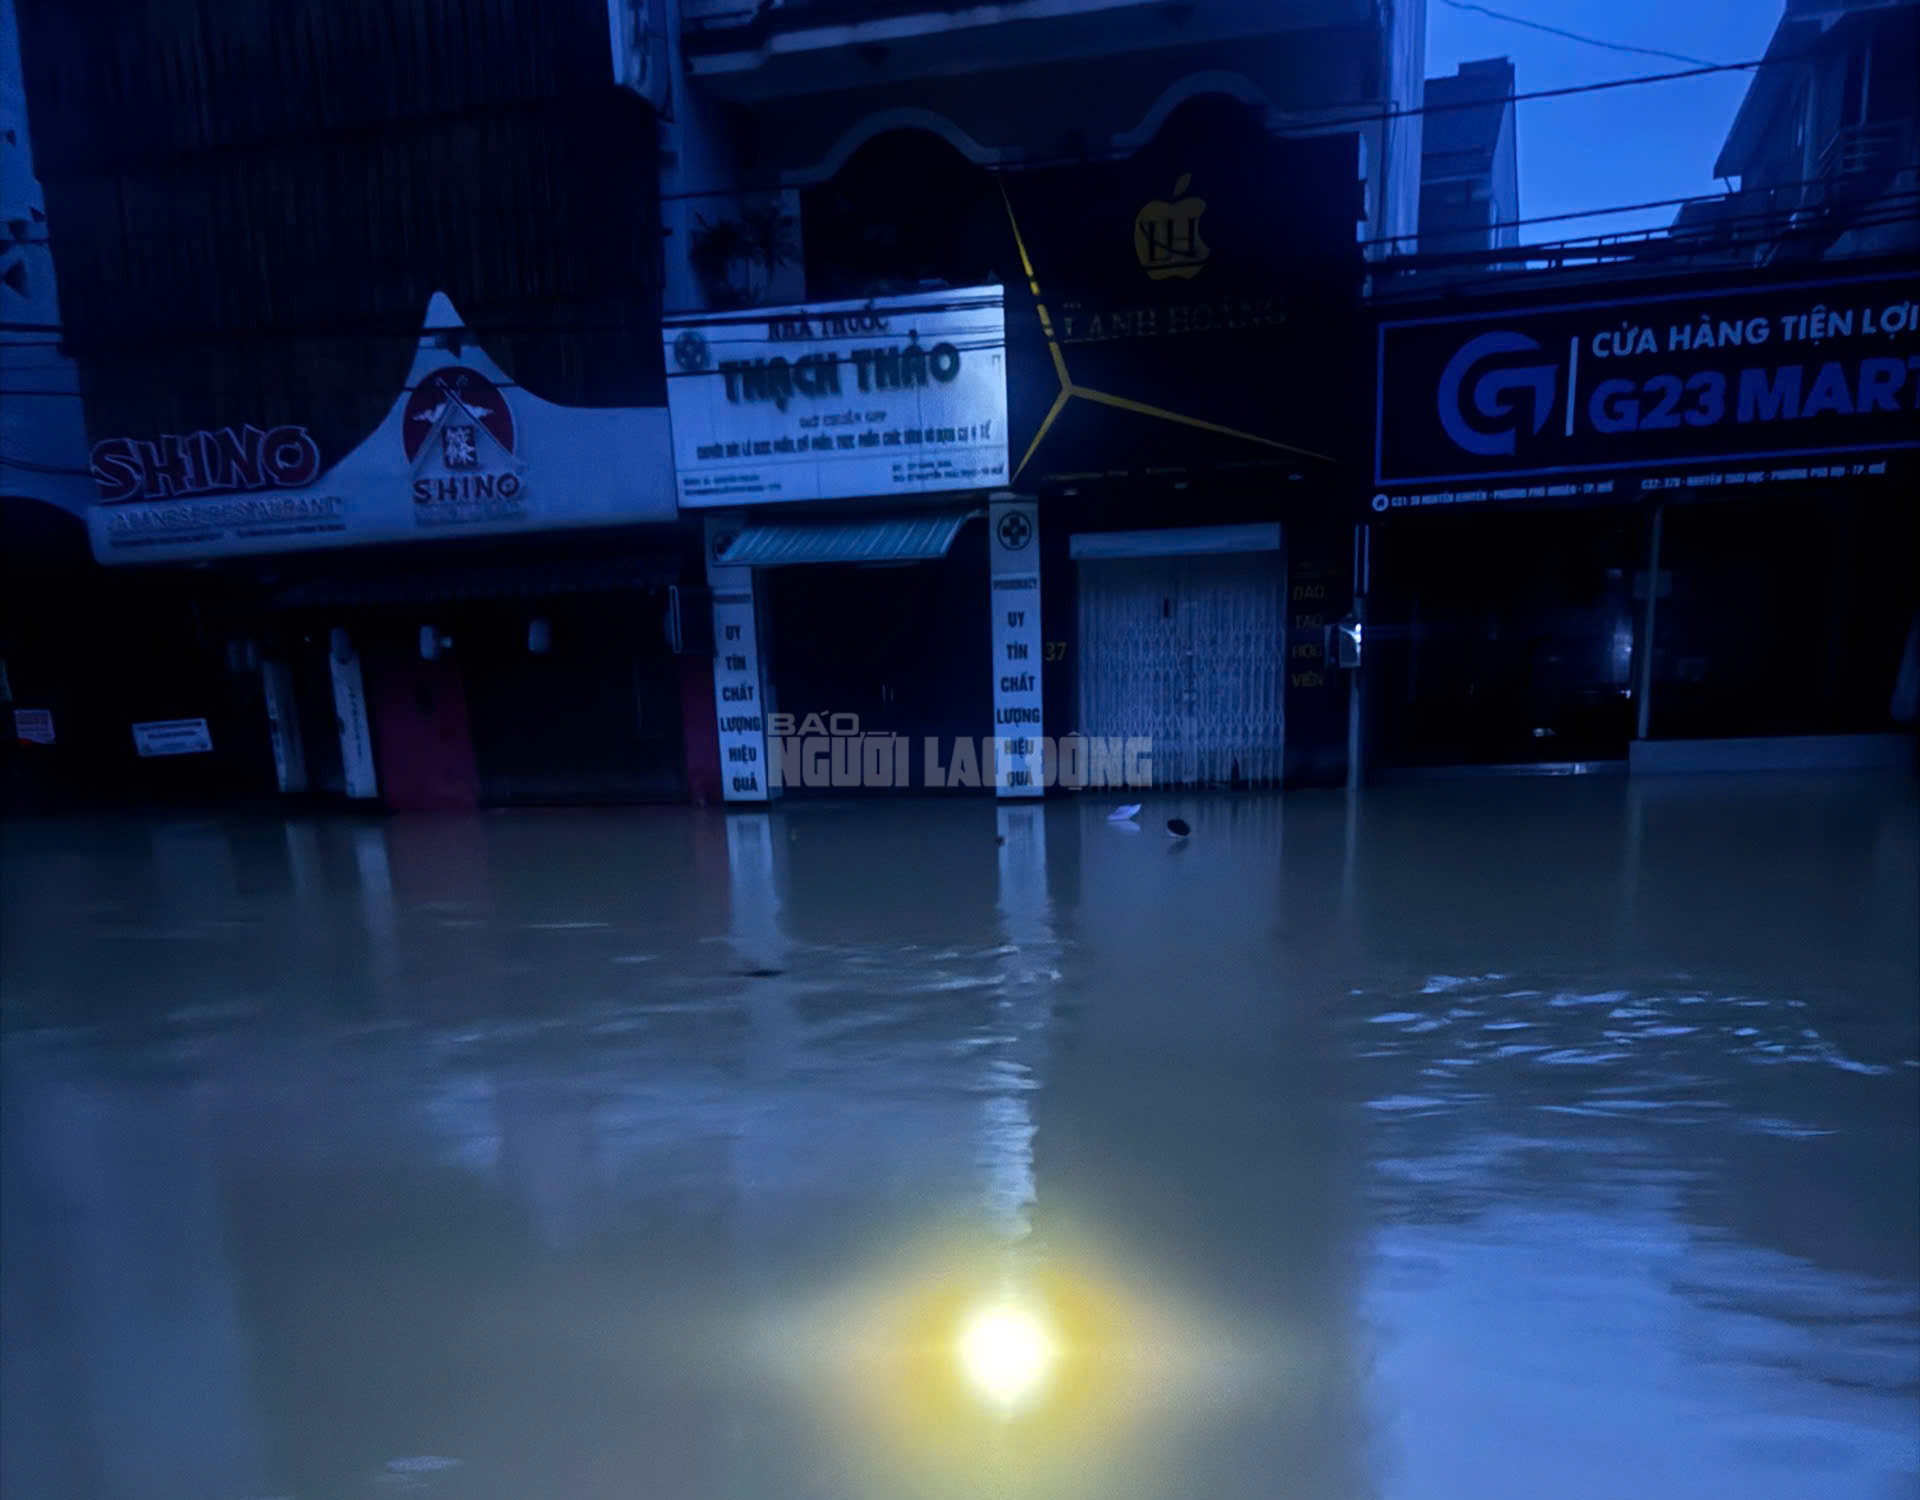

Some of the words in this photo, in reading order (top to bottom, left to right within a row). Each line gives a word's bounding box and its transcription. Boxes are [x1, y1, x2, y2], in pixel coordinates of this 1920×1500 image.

[1592, 320, 1658, 359] CỬA
[1667, 313, 1770, 352] HÀNG
[1780, 304, 1854, 347] TIỆN
[719, 355, 843, 414] THẠCH
[849, 328, 961, 393] THẢO
[1588, 370, 1727, 435] G23
[1735, 355, 1920, 423] MAR
[88, 423, 321, 504] SHINO
[413, 473, 520, 504] SHINO
[1007, 610, 1026, 629] UY
[724, 624, 742, 642] UY
[1005, 641, 1029, 661] TÍN
[1044, 642, 1068, 661] 37
[725, 654, 747, 671] TÍN
[721, 681, 755, 702] CHẤT
[1000, 671, 1036, 693] CHẤT
[719, 716, 762, 735] LƯỢNG
[996, 707, 1041, 728] LƯỢNG
[728, 743, 758, 765] HIỆU
[732, 771, 759, 793] QUẢ
